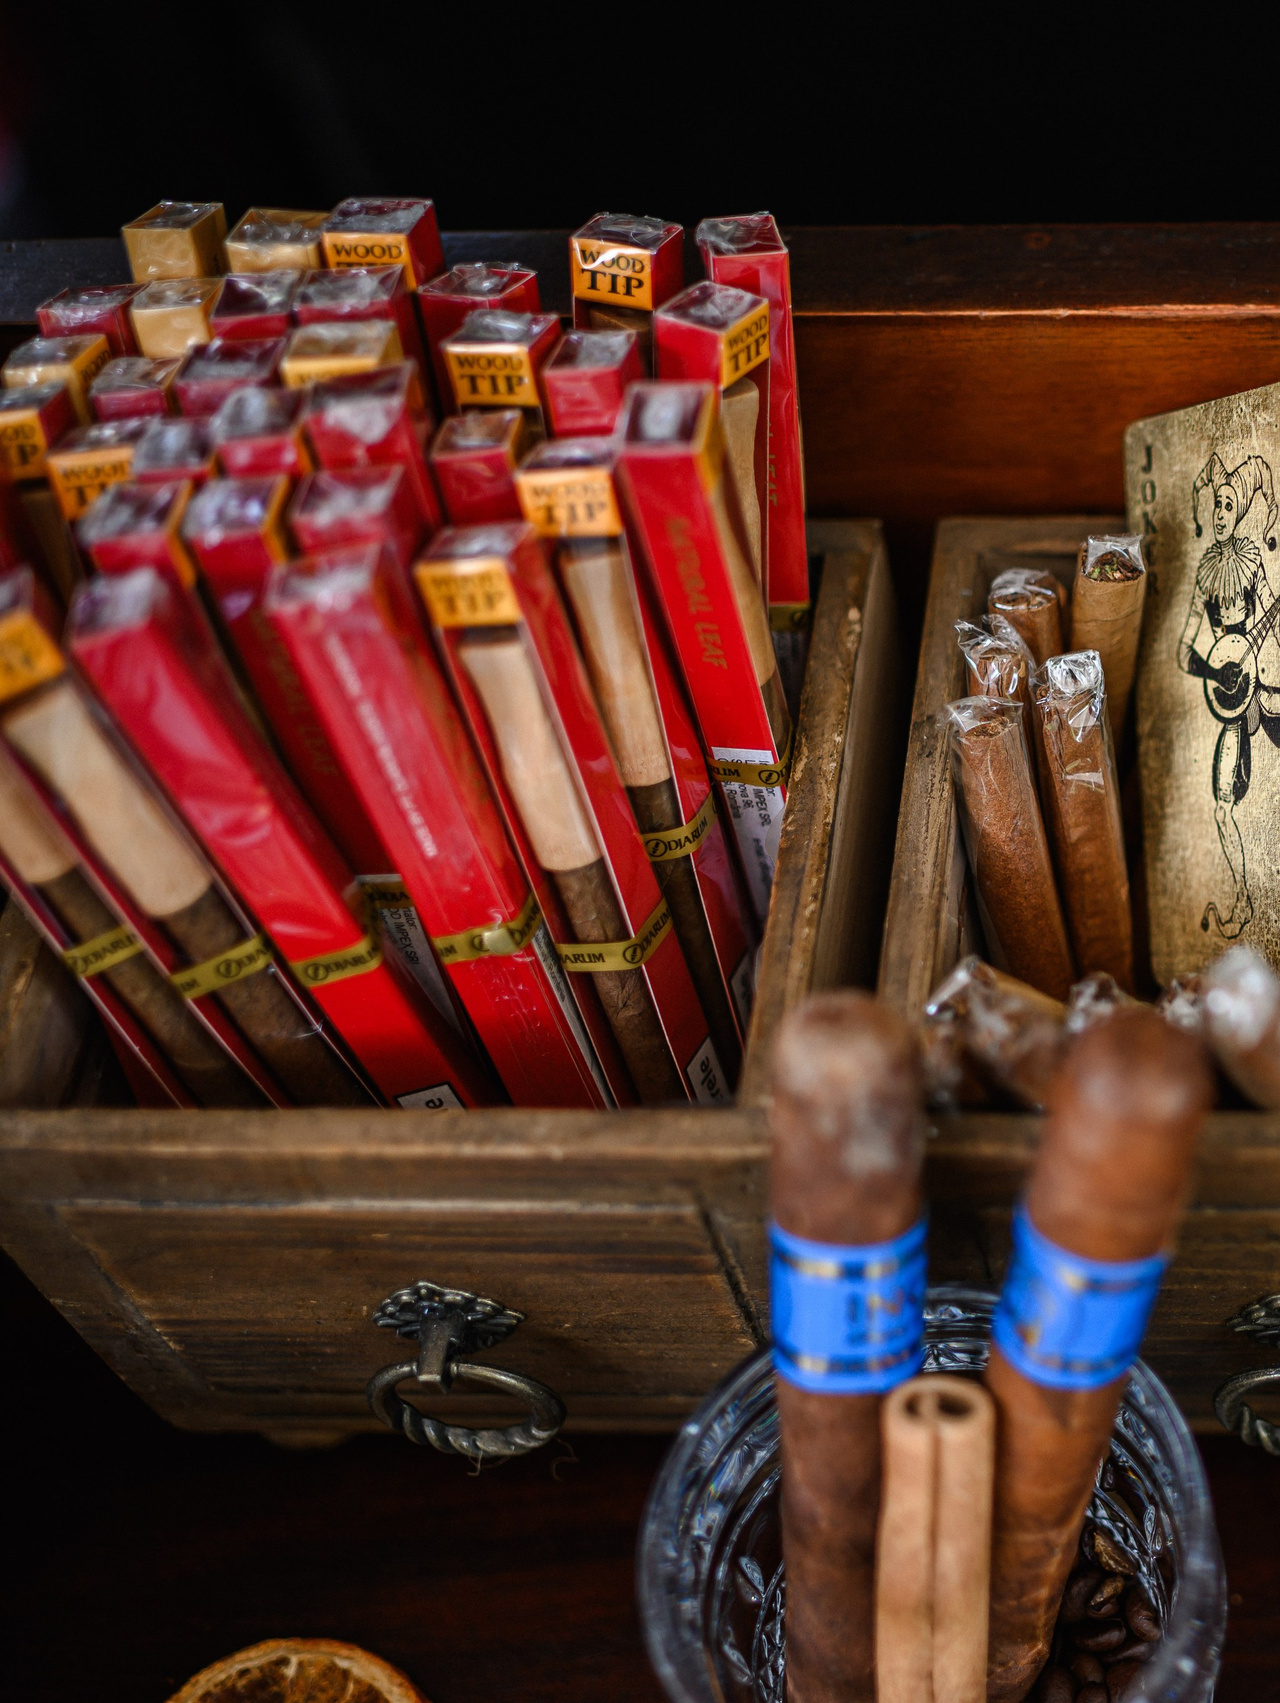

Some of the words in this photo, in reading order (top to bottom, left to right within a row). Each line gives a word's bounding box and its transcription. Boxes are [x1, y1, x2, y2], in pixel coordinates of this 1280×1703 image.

[333, 243, 403, 259] WOOD
[580, 249, 645, 274] WOOD
[581, 269, 645, 297] TIP
[728, 314, 768, 349] WOOD
[456, 355, 524, 371] WOOD
[729, 335, 768, 373] TIP
[460, 373, 526, 396] TIP
